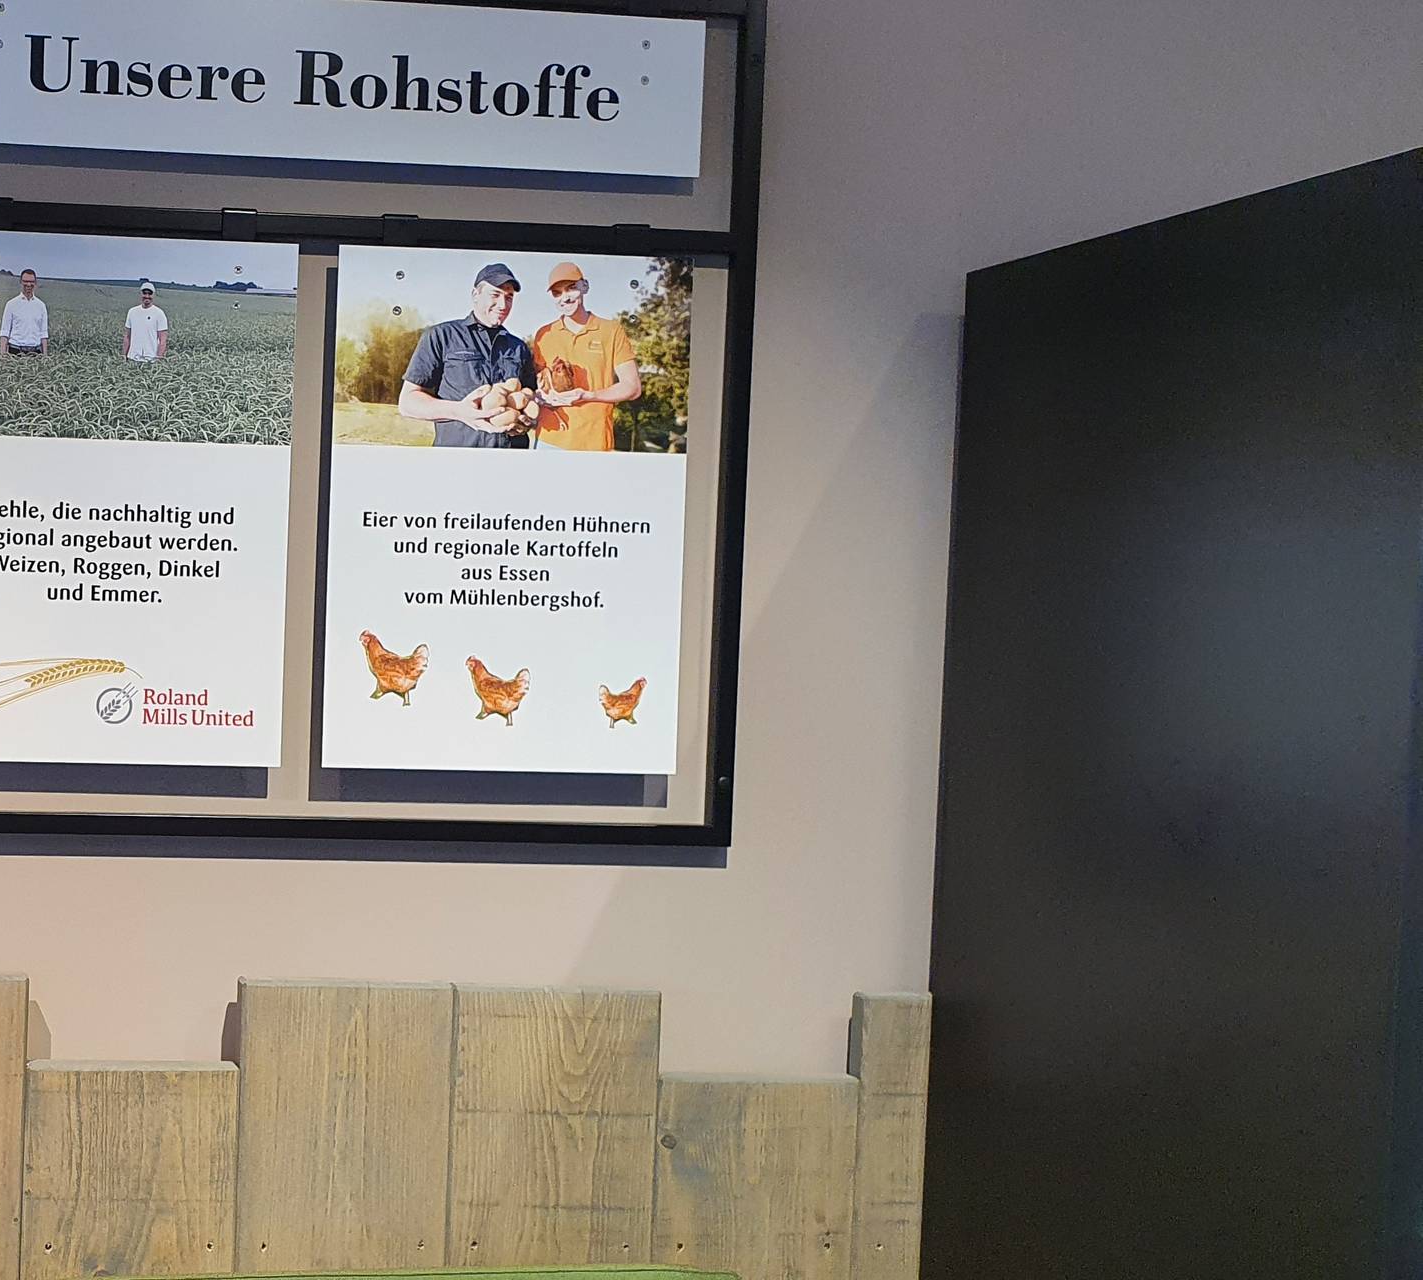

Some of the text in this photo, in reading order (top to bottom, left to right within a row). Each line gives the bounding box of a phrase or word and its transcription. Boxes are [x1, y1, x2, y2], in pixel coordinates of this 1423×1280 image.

[25, 34, 621, 123] Unsere Rohstoffe
[52, 501, 82, 520] die
[89, 504, 192, 528] nachhaltig
[199, 507, 235, 525] und
[362, 512, 650, 534] Eier von freilaufenden Hühnern
[61, 531, 152, 552] angebaut
[159, 533, 238, 552] werden.
[394, 537, 618, 559] und regionale Kartoffeln
[73, 558, 152, 580] Roggen,
[159, 560, 220, 578] Dinkel
[461, 566, 550, 581] aus Essen
[47, 583, 162, 603] und Emmer.
[405, 589, 604, 611] vom Mühlenbergshof.
[143, 689, 208, 706] Roland
[142, 709, 254, 727] Mills United
